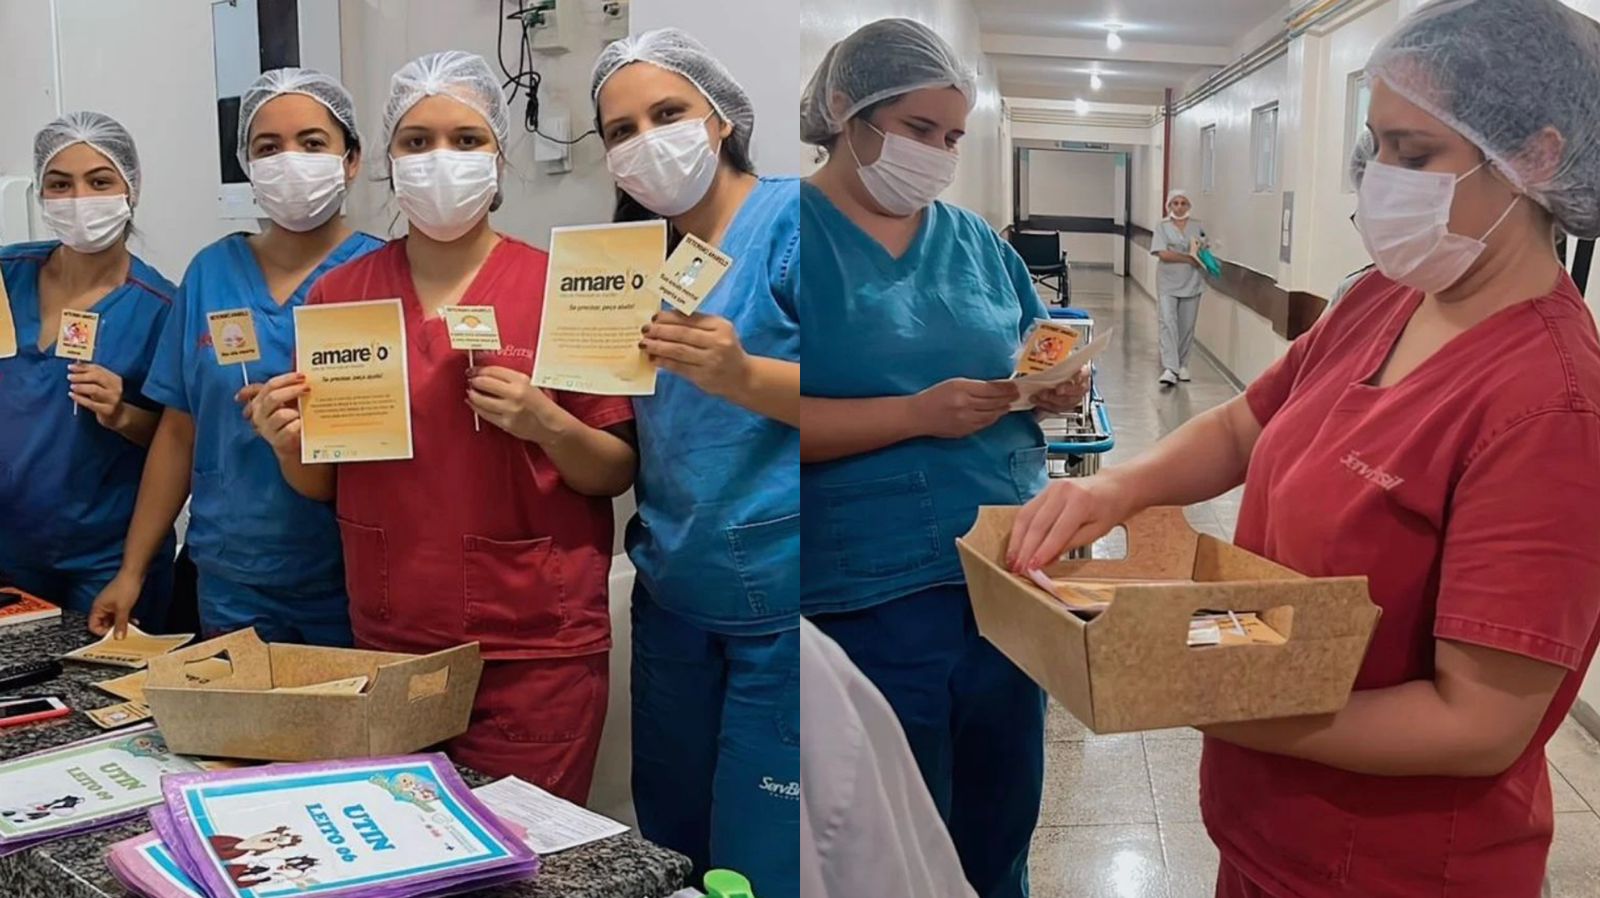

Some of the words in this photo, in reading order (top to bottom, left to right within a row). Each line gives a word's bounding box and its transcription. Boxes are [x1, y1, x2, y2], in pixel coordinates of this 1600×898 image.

[66, 767, 103, 791] LEITO
[99, 762, 147, 790] UTIN
[305, 803, 345, 845] LEITO
[343, 804, 396, 851] UTIN
